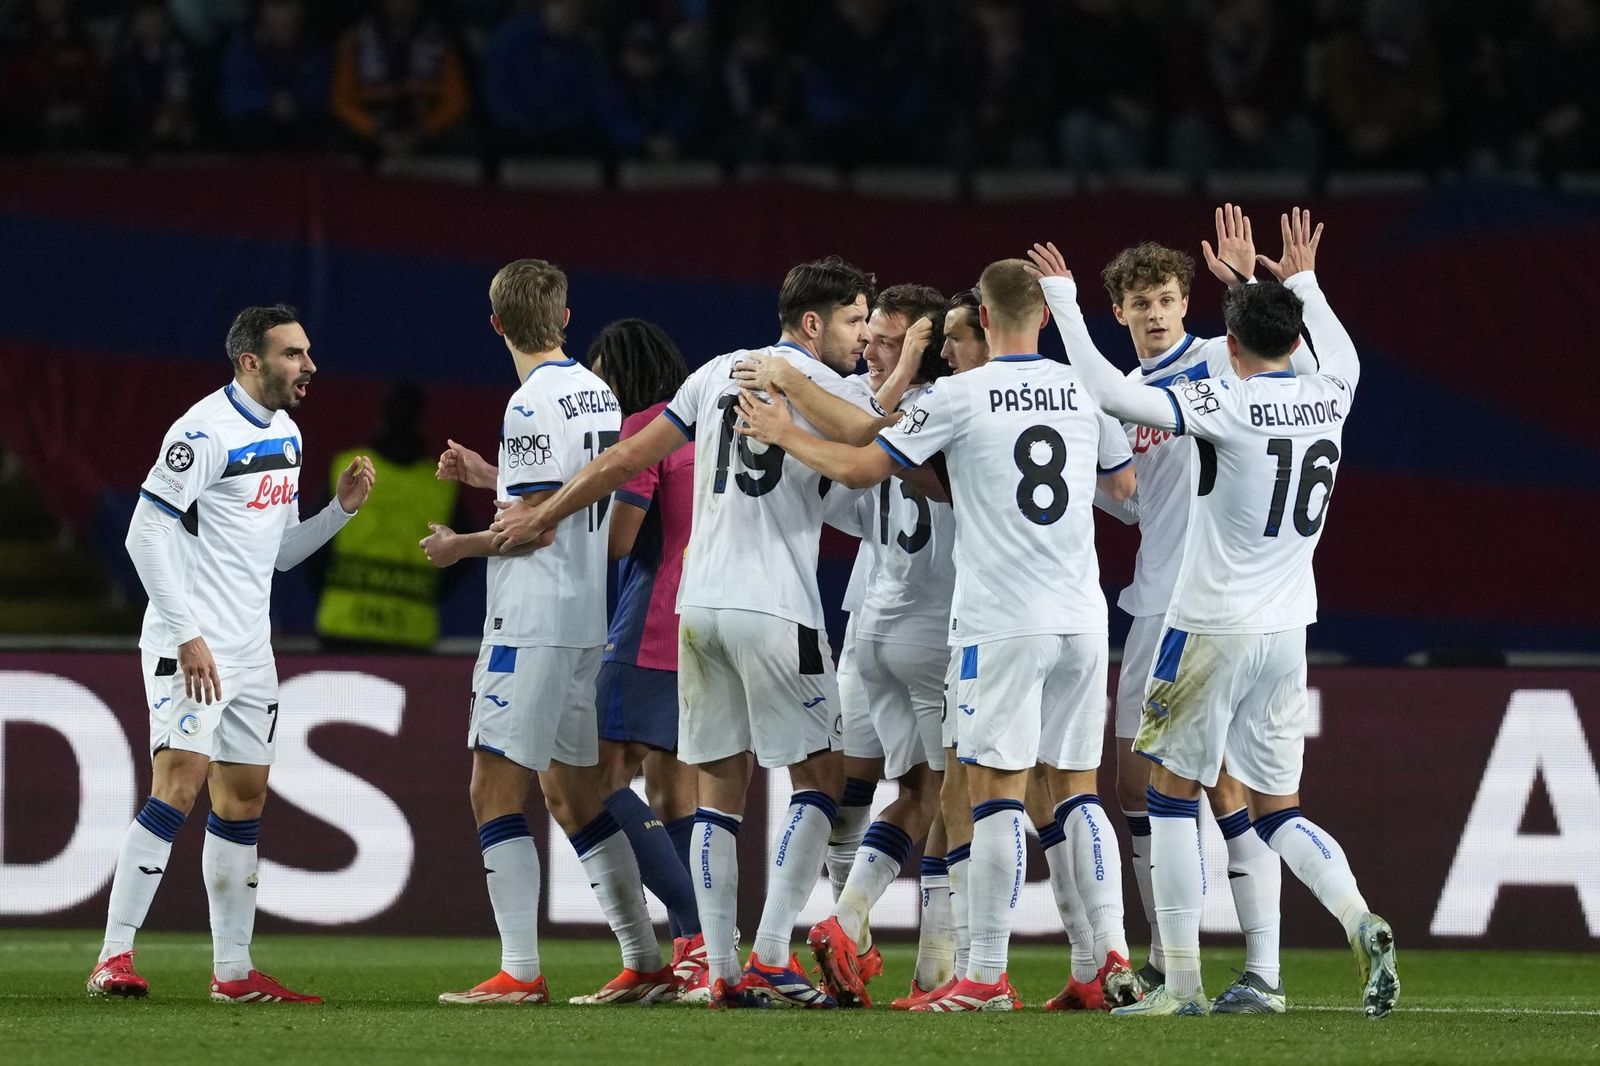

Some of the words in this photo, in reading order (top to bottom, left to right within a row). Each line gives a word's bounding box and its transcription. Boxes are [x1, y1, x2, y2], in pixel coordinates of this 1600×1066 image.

[558, 394, 579, 420] DE
[990, 383, 1078, 412] PAŠALIĆ
[507, 434, 551, 455] RADICI
[508, 449, 552, 469] GROUP
[1014, 425, 1069, 526] 8
[1263, 438, 1340, 538] 16
[246, 474, 295, 510] Lete
[267, 702, 279, 744] 7
